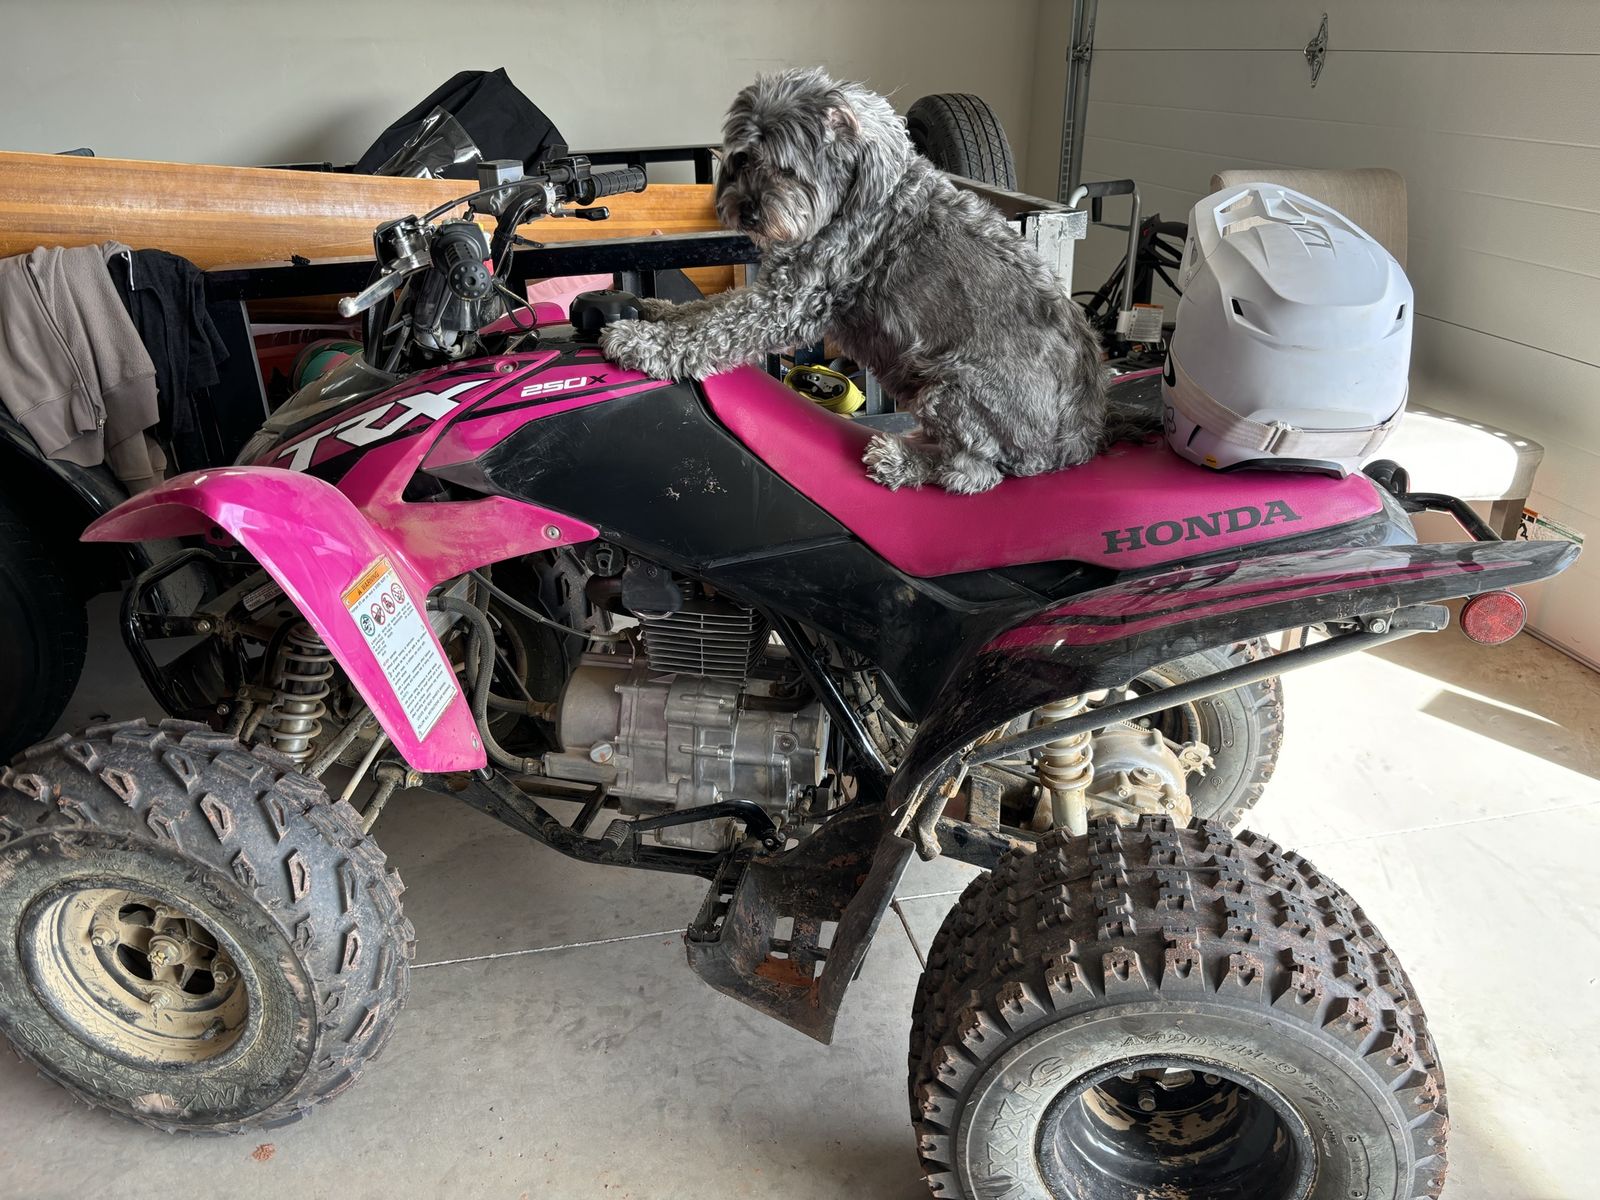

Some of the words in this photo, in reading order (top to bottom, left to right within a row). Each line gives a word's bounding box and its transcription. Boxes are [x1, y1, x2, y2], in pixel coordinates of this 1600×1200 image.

[520, 373, 608, 398] 250X
[277, 378, 494, 472] TRX
[1101, 499, 1303, 555] HONDA
[360, 569, 379, 591] WARNING
